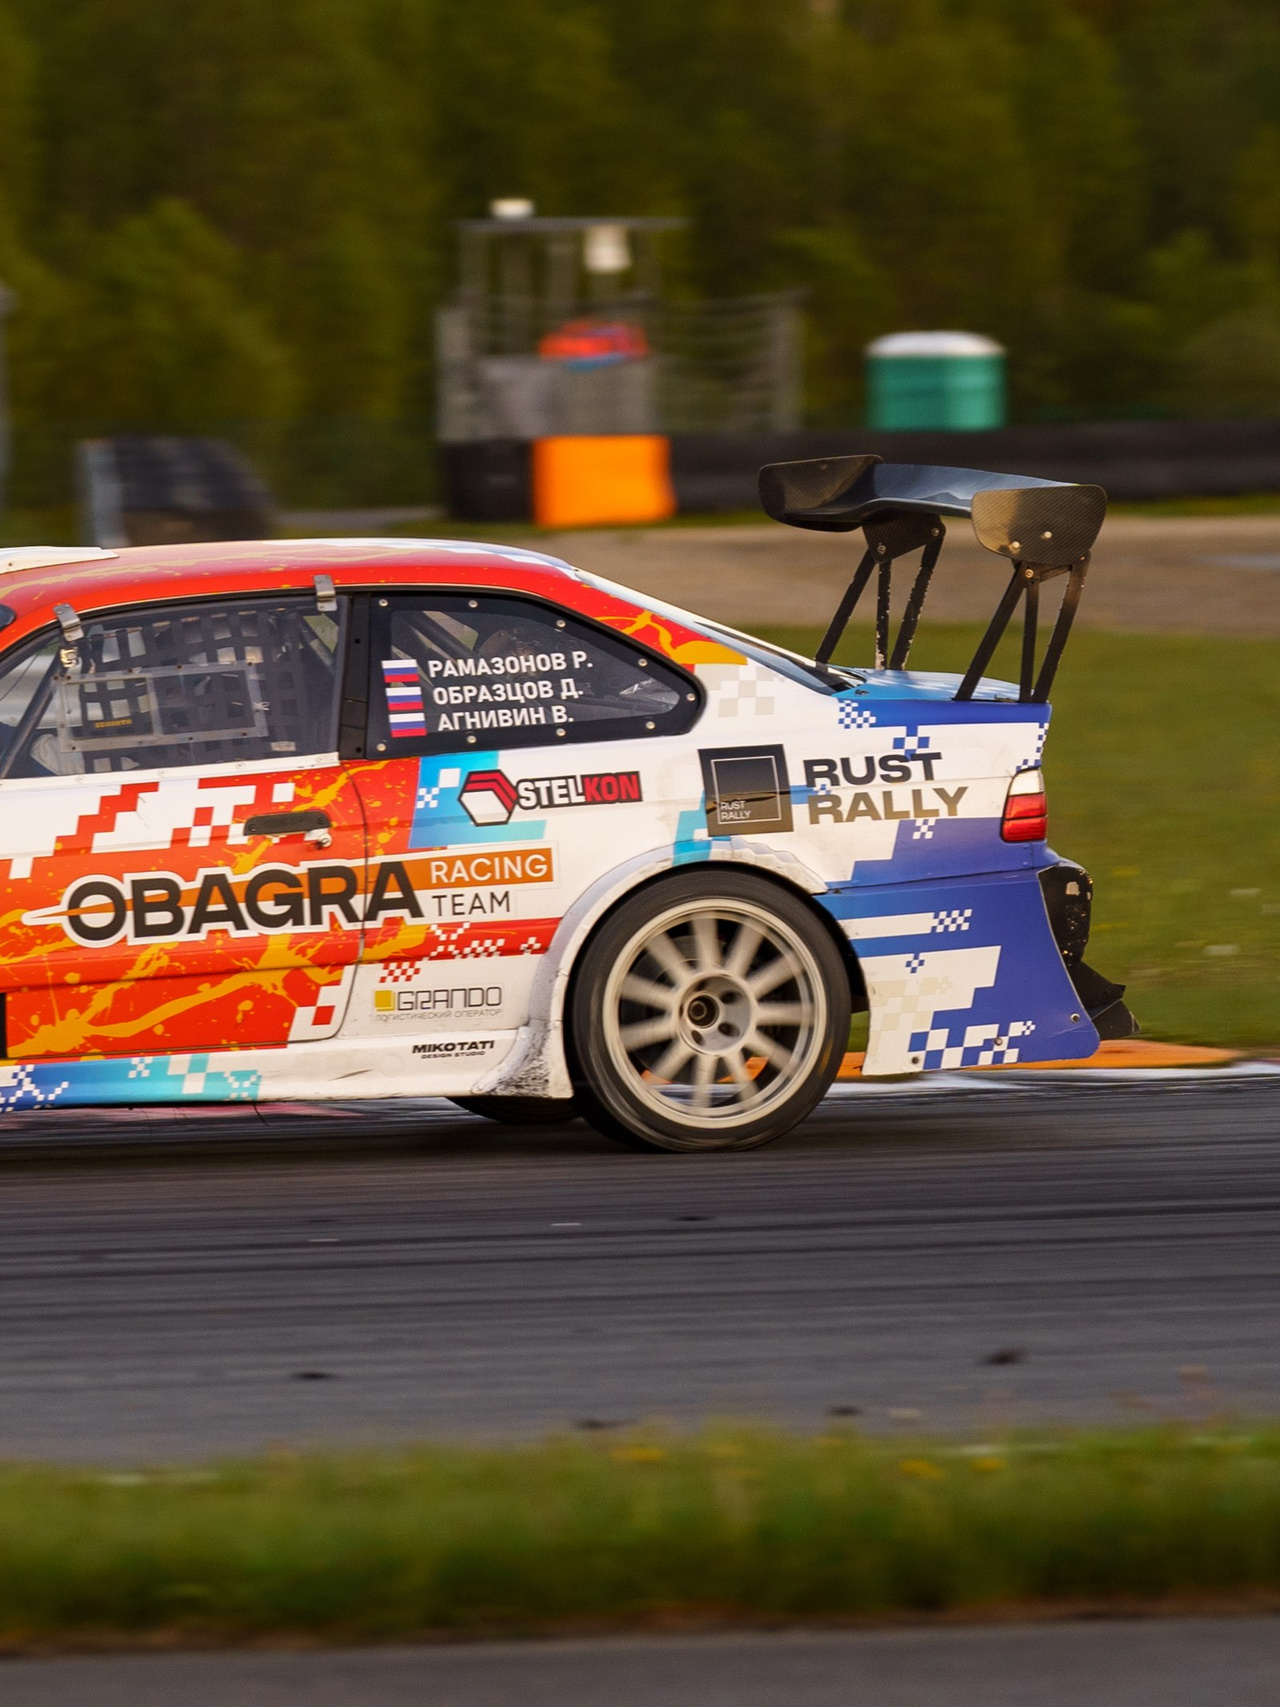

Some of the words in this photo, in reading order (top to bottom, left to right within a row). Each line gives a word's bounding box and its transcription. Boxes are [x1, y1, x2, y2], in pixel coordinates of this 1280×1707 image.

[428, 653, 567, 678] РАМАЗОНОВ
[573, 650, 593, 669] Р.
[432, 680, 554, 706] ОБРАЗЦОВ
[561, 678, 584, 701] Д.
[438, 706, 547, 732] АГНИВИН
[551, 705, 574, 724] В.
[803, 752, 942, 787] RUST
[517, 772, 642, 808] STELKON
[721, 810, 752, 821] RALLY
[807, 786, 969, 825] RALLY
[430, 854, 549, 884] RACING
[67, 861, 425, 942] OBAGRA
[432, 891, 512, 917] TEAM
[397, 986, 502, 1010] GRANDO
[412, 1040, 495, 1053] MIKOTATI
